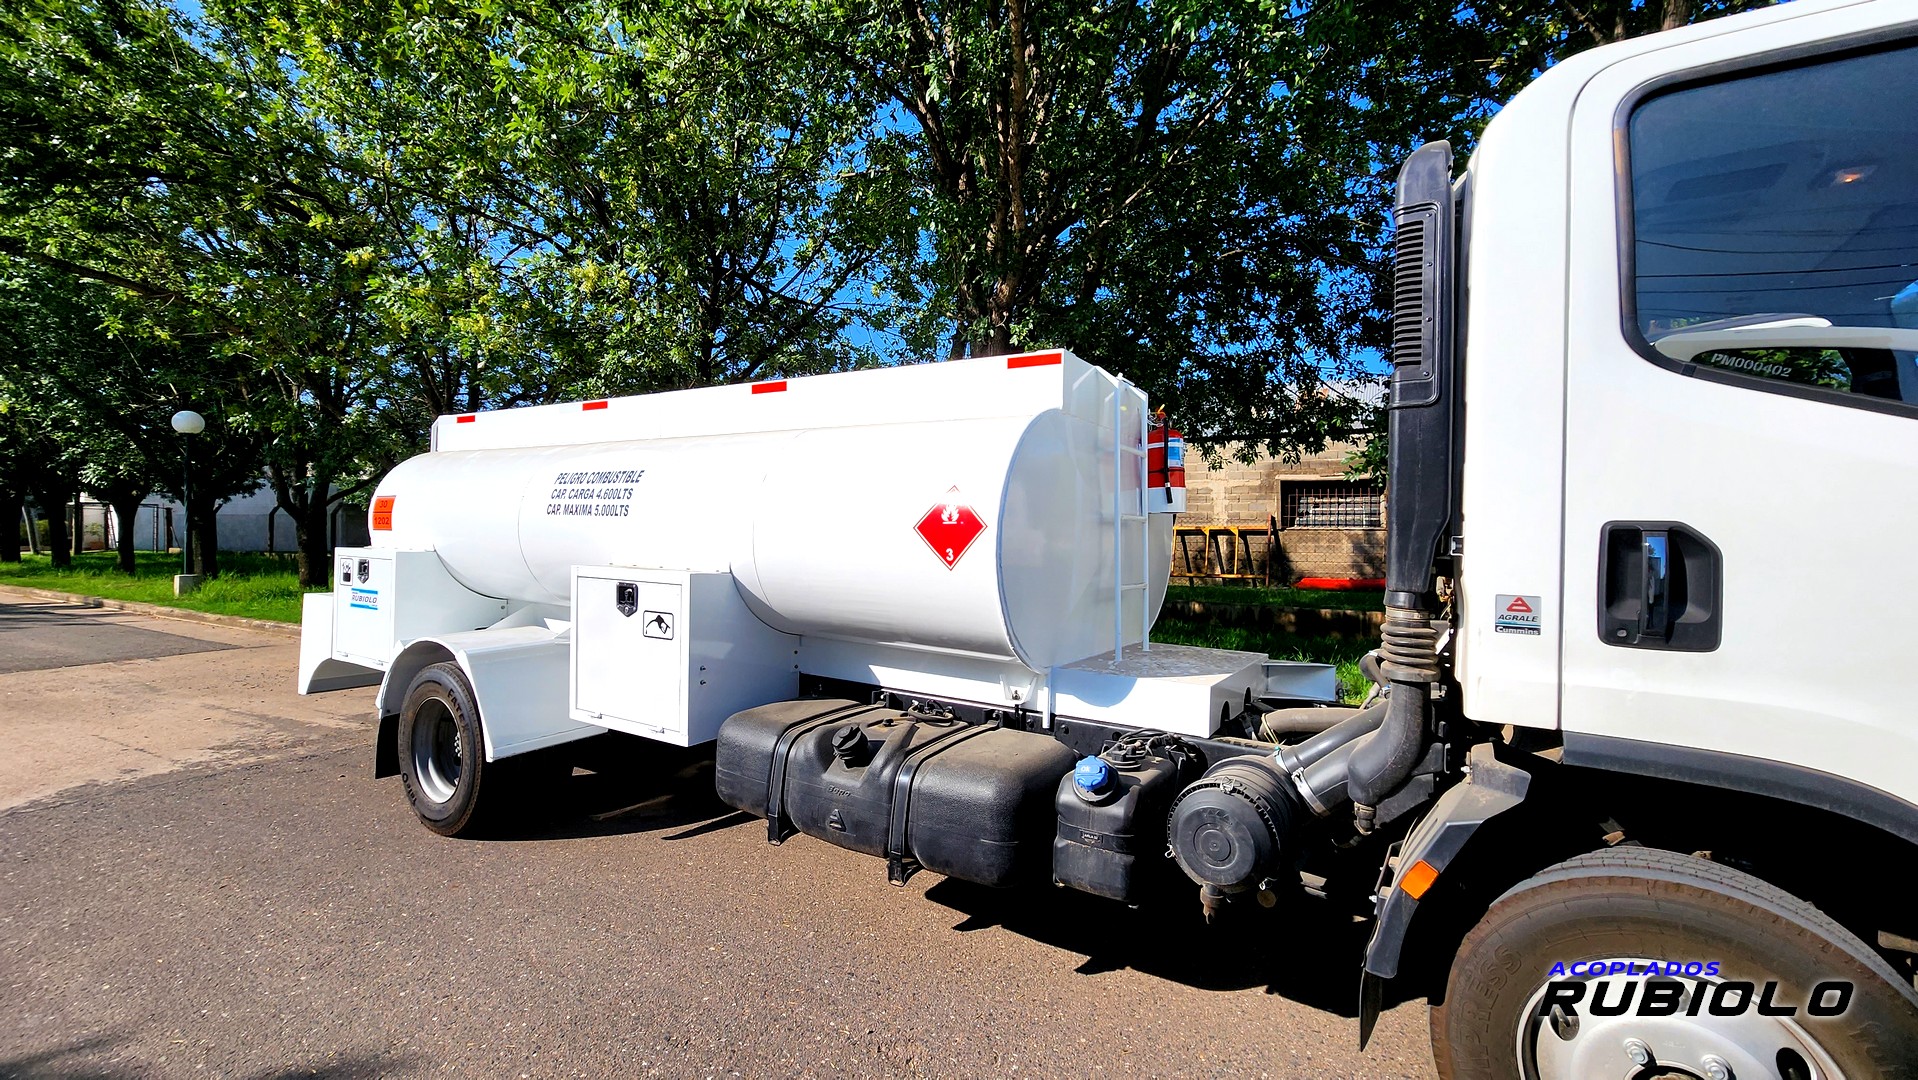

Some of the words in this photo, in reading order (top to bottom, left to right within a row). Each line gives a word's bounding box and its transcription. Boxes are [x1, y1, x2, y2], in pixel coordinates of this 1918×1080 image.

[1711, 353, 1792, 377] PM000402
[554, 472, 588, 484] PELIGRO
[586, 470, 645, 484] COMBUSTIBLE
[551, 488, 566, 499] CAP.
[568, 488, 595, 500] CARGA
[596, 488, 633, 500] 4.600LTS
[380, 500, 388, 508] 30
[563, 503, 592, 516] MAXIMA
[594, 504, 629, 516] 5.000LTS
[374, 516, 390, 525] 1202
[945, 547, 954, 561] 3
[352, 594, 378, 603] RUBIOLO
[1498, 614, 1539, 622] AGRALE
[1496, 626, 1540, 635] Cummins
